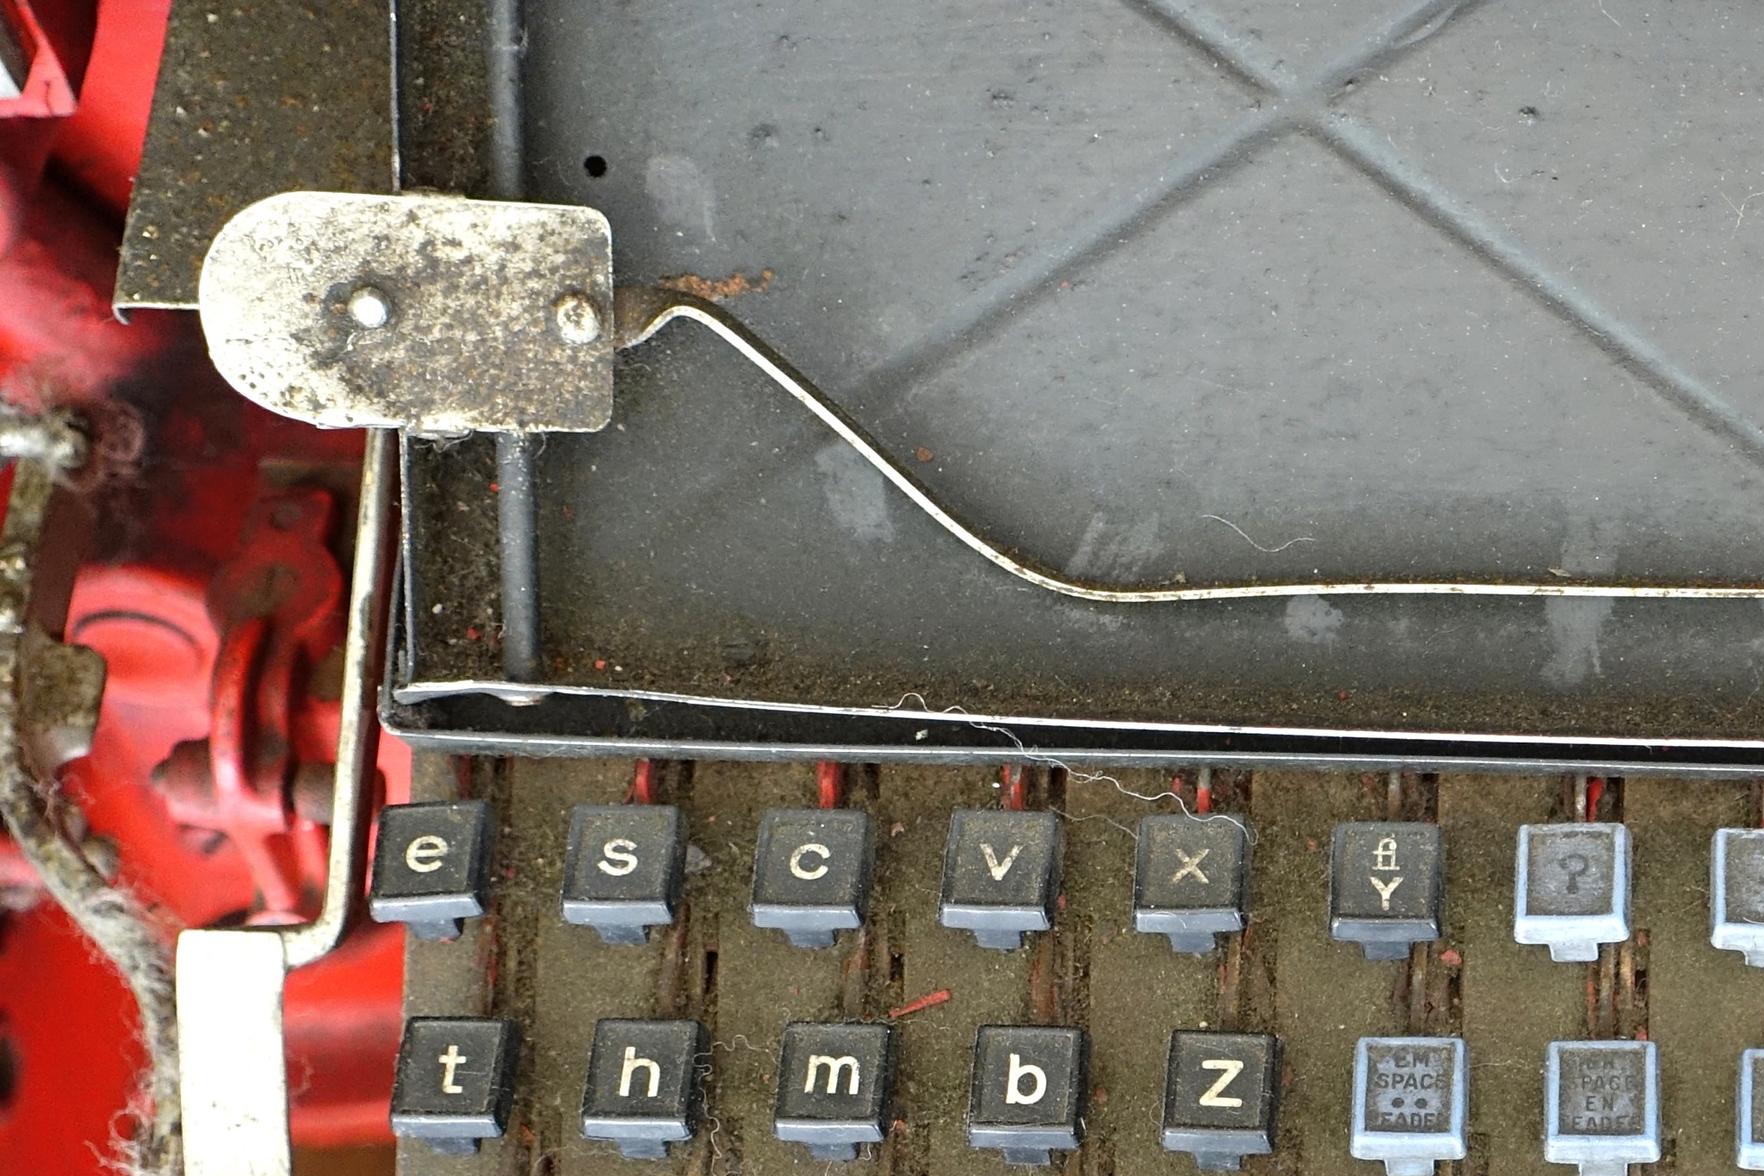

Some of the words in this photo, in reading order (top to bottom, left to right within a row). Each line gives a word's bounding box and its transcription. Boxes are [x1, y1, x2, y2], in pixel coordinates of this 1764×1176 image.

[406, 835, 448, 872] e
[598, 838, 637, 876] s
[789, 843, 829, 880] c
[979, 843, 1020, 881] v
[1172, 848, 1209, 884] x
[1558, 854, 1588, 894] ?
[1369, 876, 1405, 912] Y
[439, 1046, 466, 1094] t
[620, 1047, 660, 1097] h
[805, 1054, 859, 1095] m
[1007, 1054, 1047, 1104] b
[1586, 1096, 1614, 1112] EN
